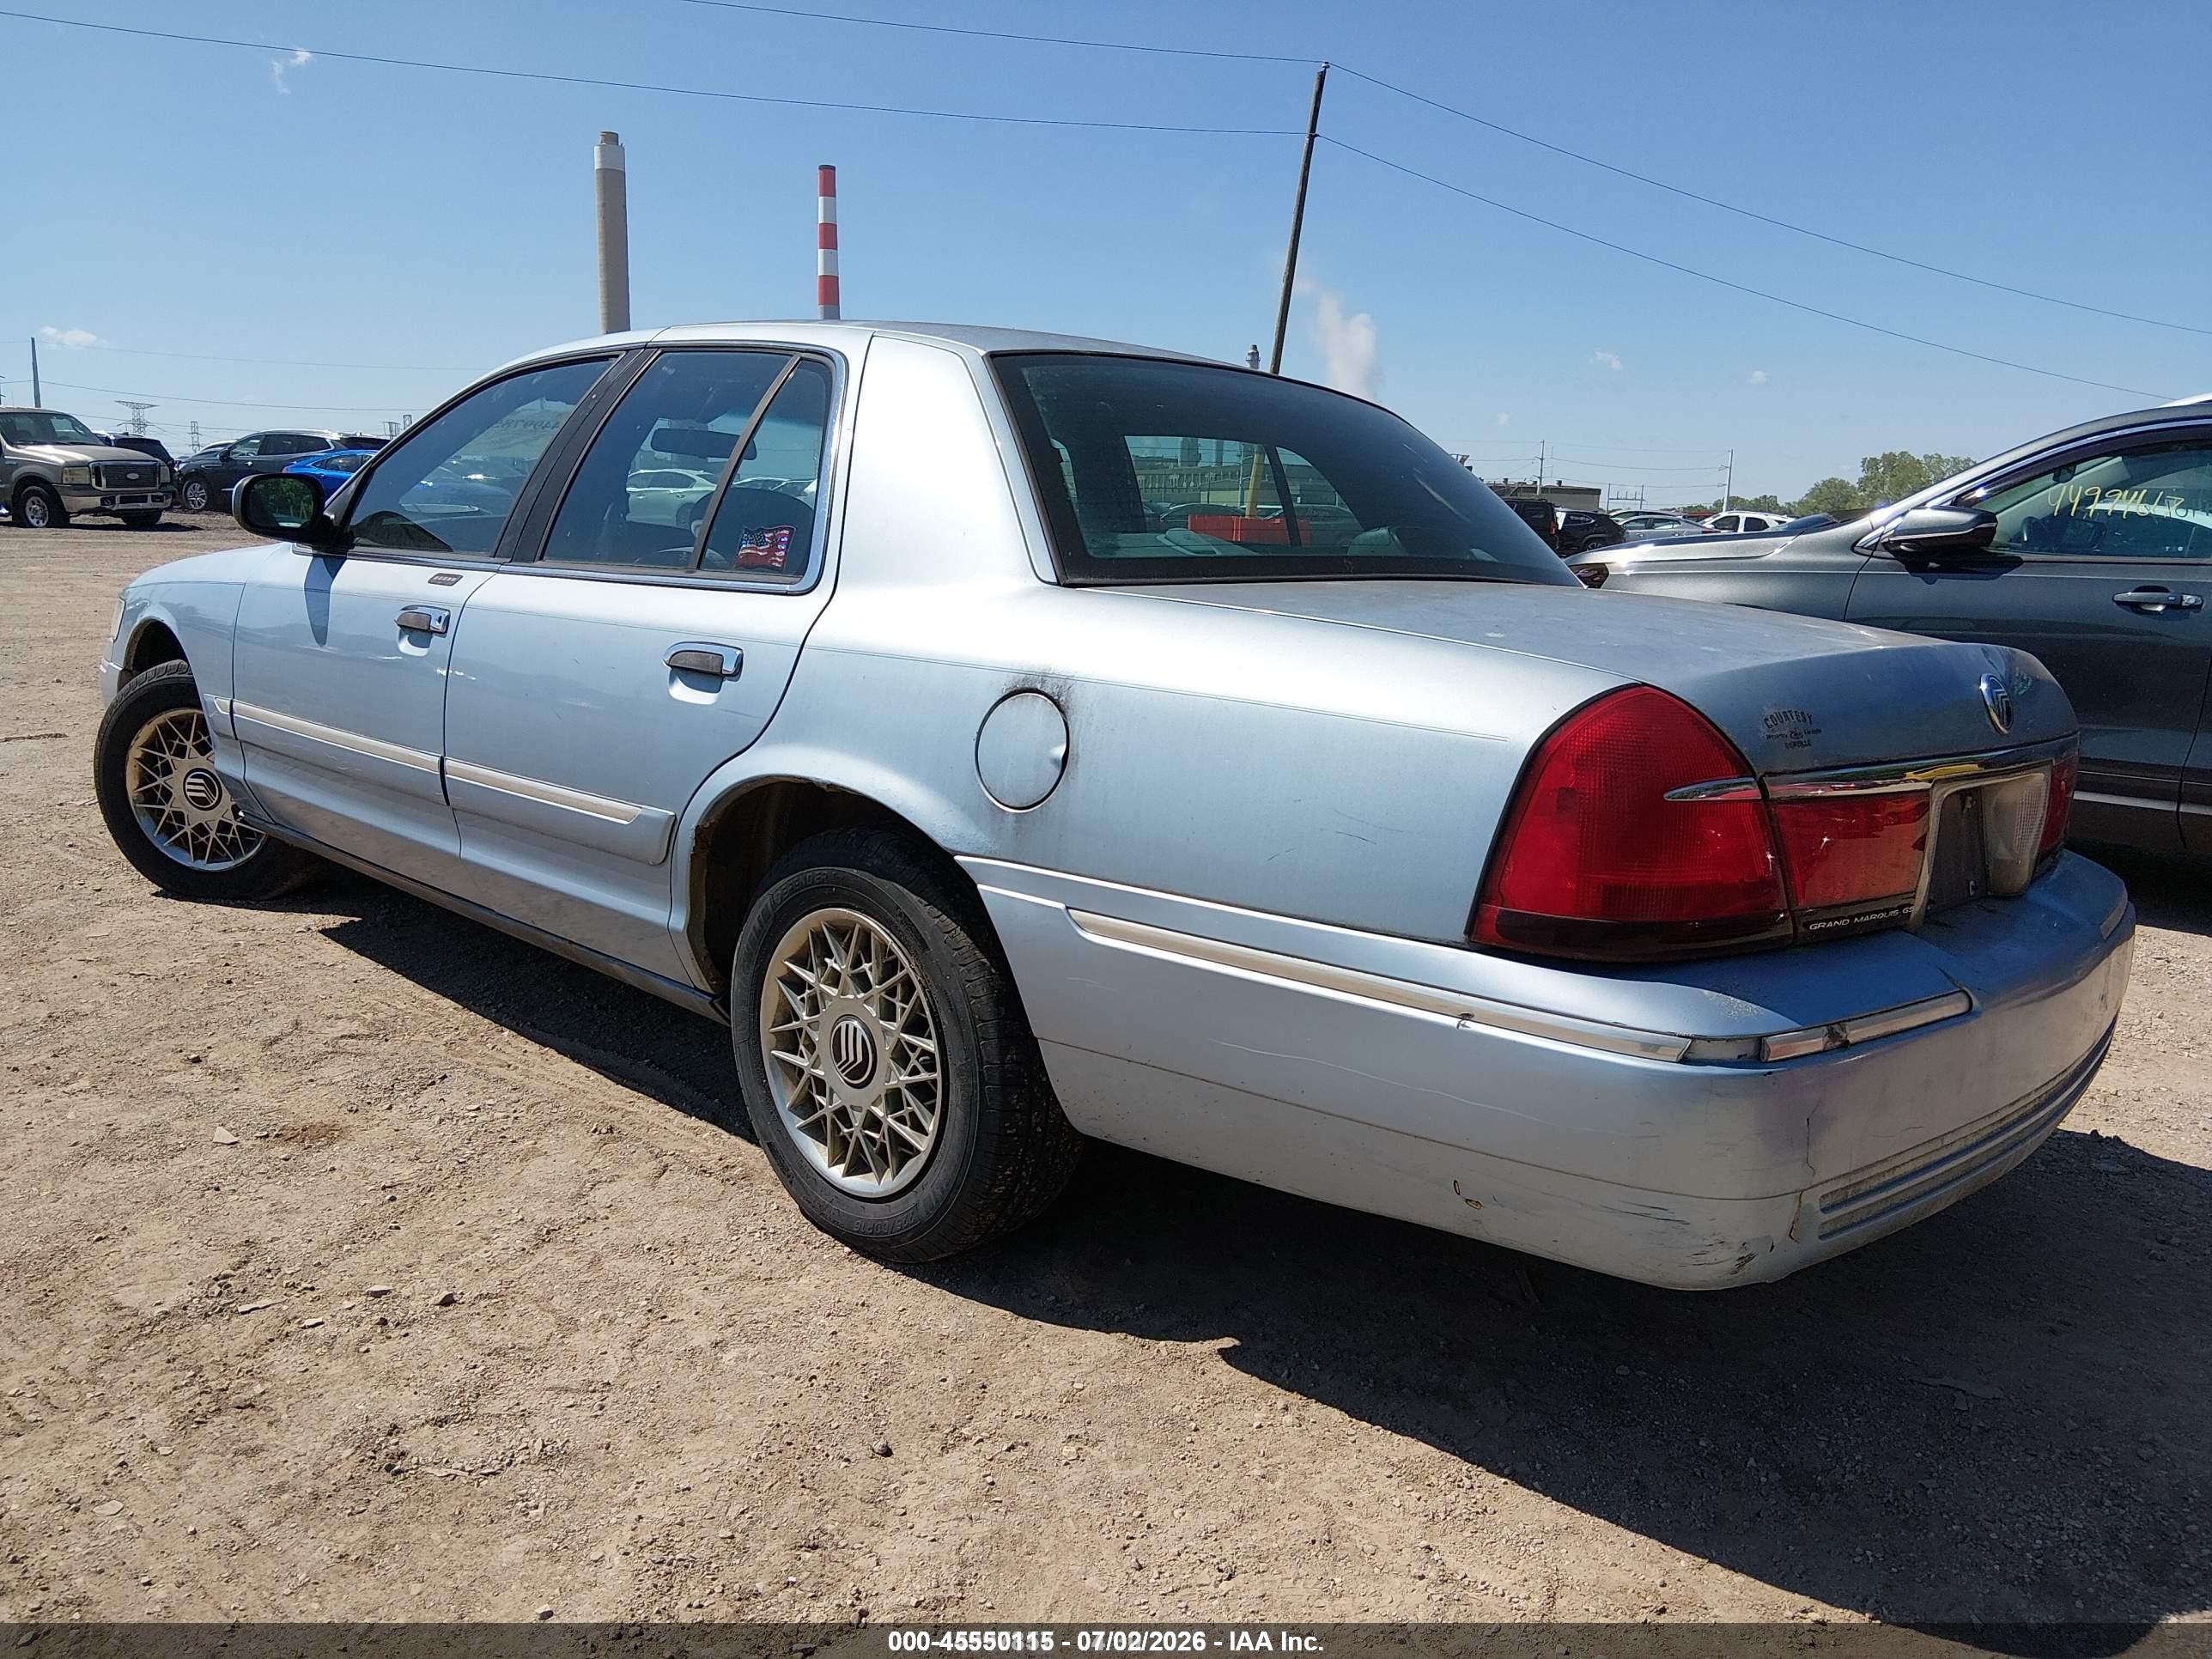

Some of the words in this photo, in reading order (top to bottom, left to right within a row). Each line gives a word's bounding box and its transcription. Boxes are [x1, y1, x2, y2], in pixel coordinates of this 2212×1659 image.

[1764, 710, 1813, 729] COURTESY
[1809, 919, 1850, 931] GRAND
[1853, 909, 1899, 923] MARQUIS
